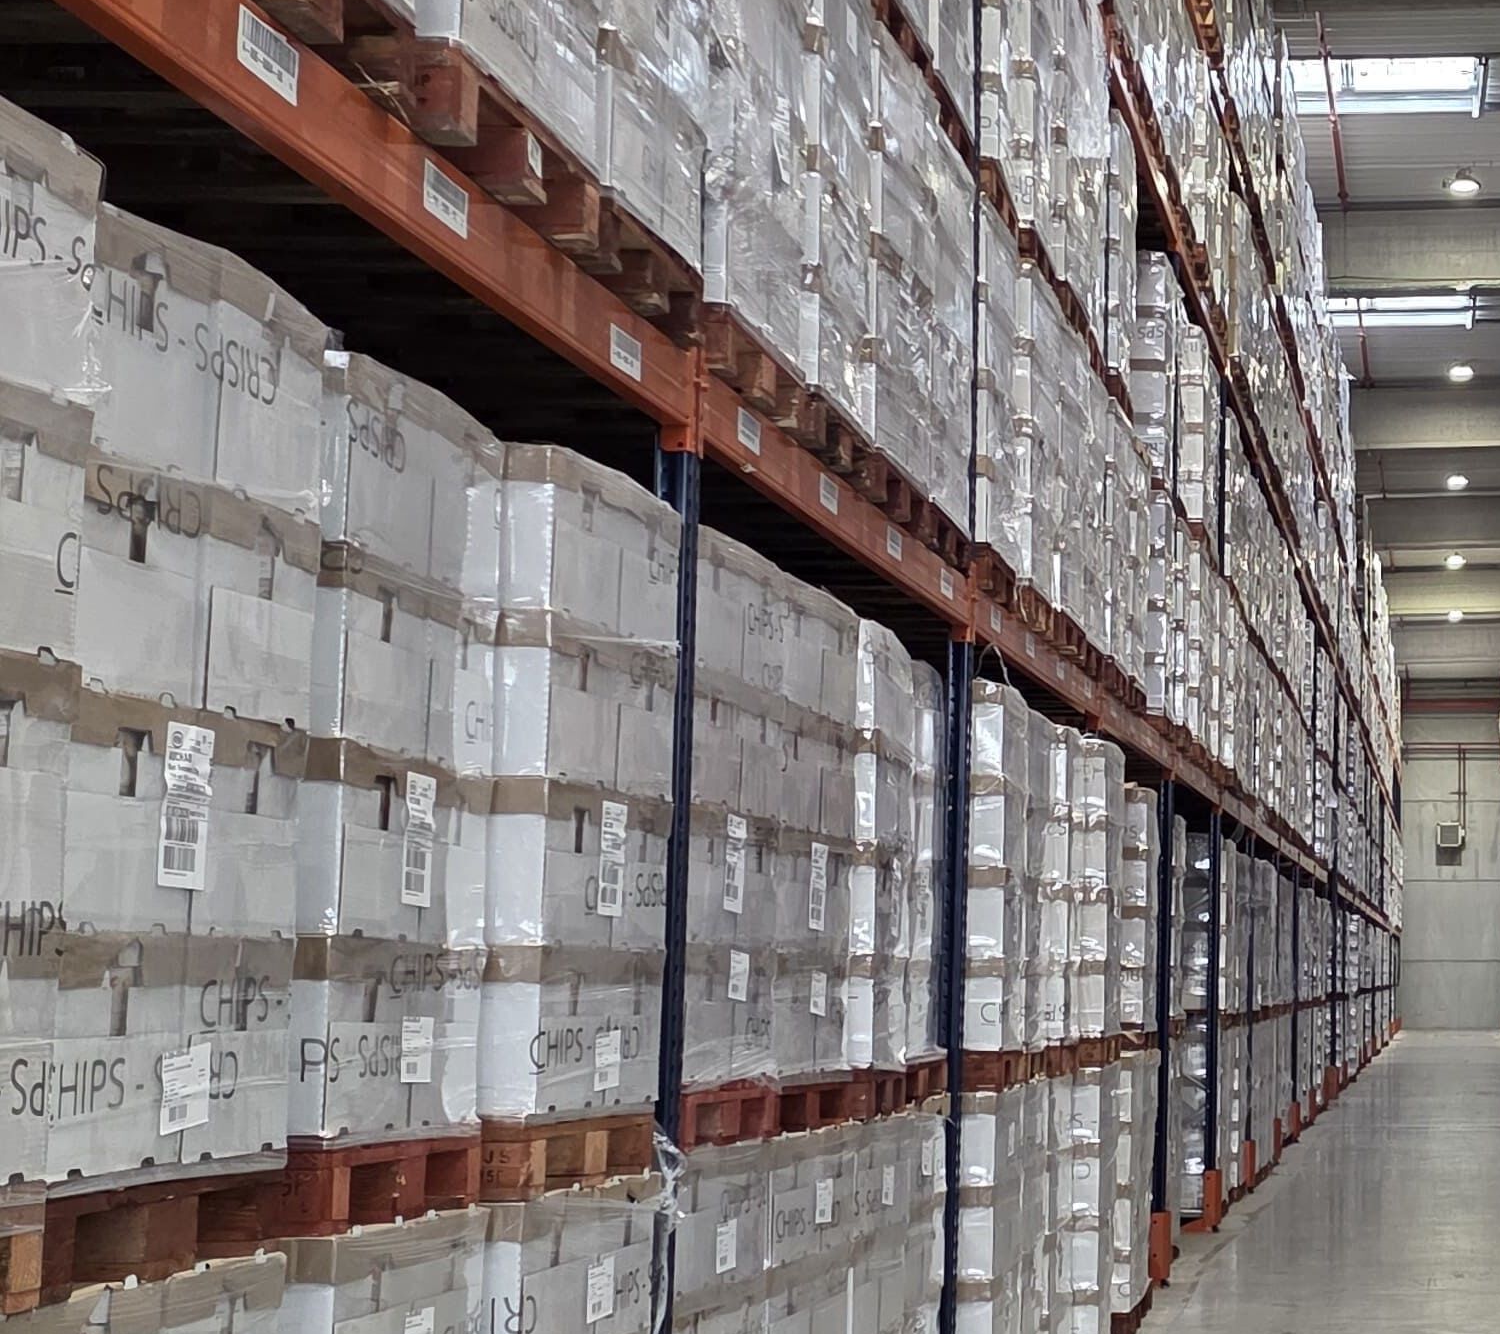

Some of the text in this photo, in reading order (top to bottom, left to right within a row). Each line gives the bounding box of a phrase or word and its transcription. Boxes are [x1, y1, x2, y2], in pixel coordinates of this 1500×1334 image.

[195, 322, 282, 405] CRISPS
[529, 1028, 584, 1071] CHIPS
[50, 1057, 126, 1120] HIPS
